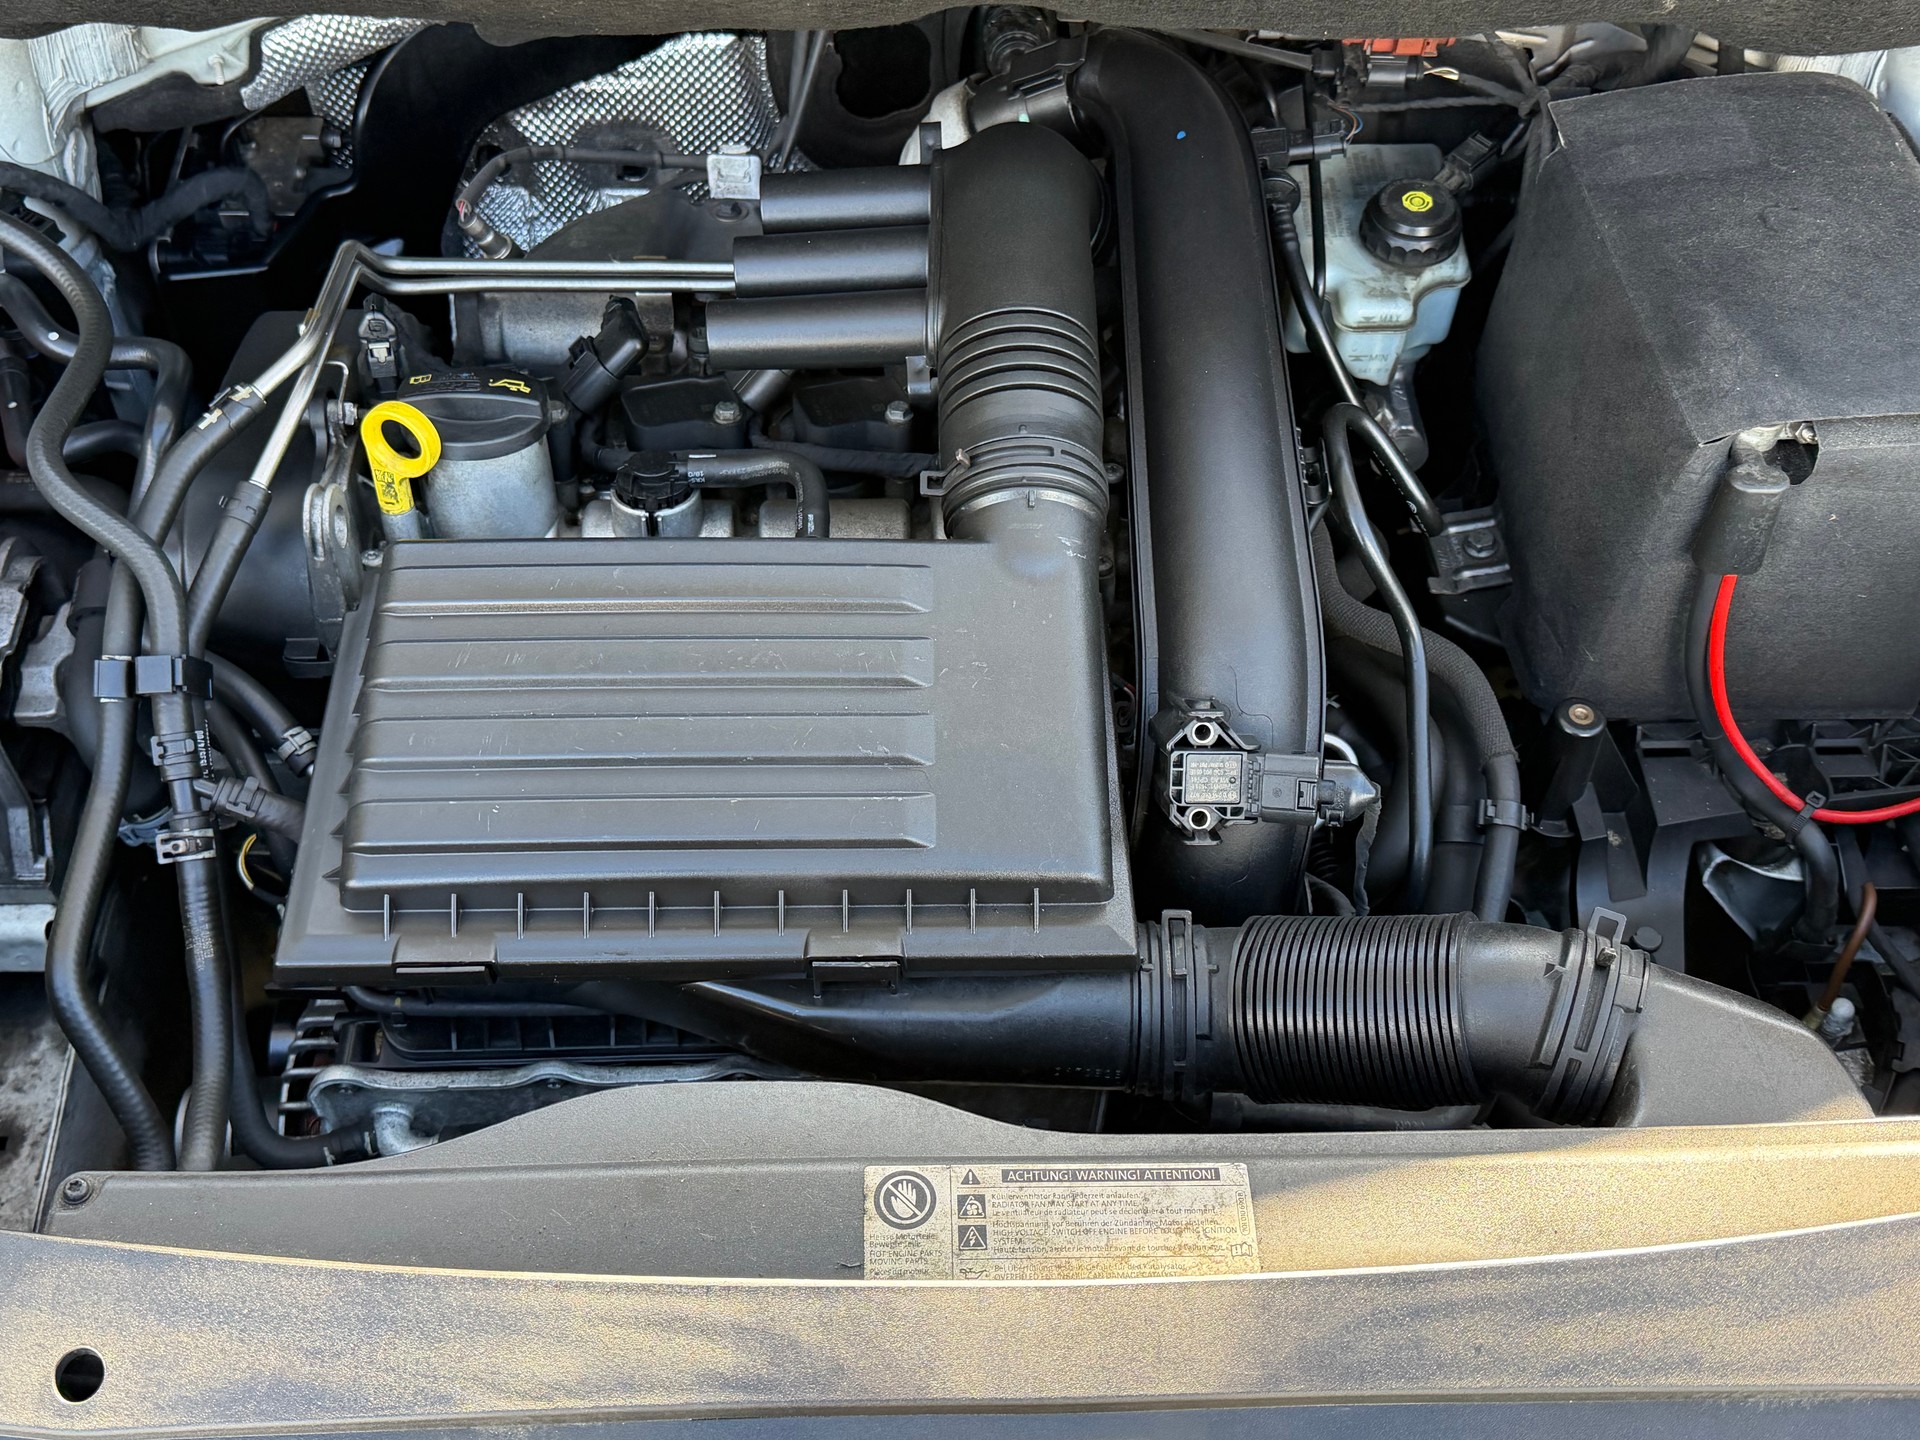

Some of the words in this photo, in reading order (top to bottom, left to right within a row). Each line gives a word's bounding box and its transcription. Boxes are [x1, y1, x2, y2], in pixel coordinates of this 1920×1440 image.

[1380, 314, 1401, 322] MAX
[1368, 354, 1389, 362] MIN
[1007, 1170, 1072, 1181] ACHTUNG!
[1075, 1169, 1140, 1181] WARNING!
[1144, 1168, 1216, 1180] ATTENTION!
[1067, 1200, 1089, 1208] START
[1129, 1227, 1159, 1235] BEFORE
[1201, 1226, 1238, 1234] IGNITION
[919, 1249, 943, 1257] PARTS
[869, 1258, 902, 1266] MOVING
